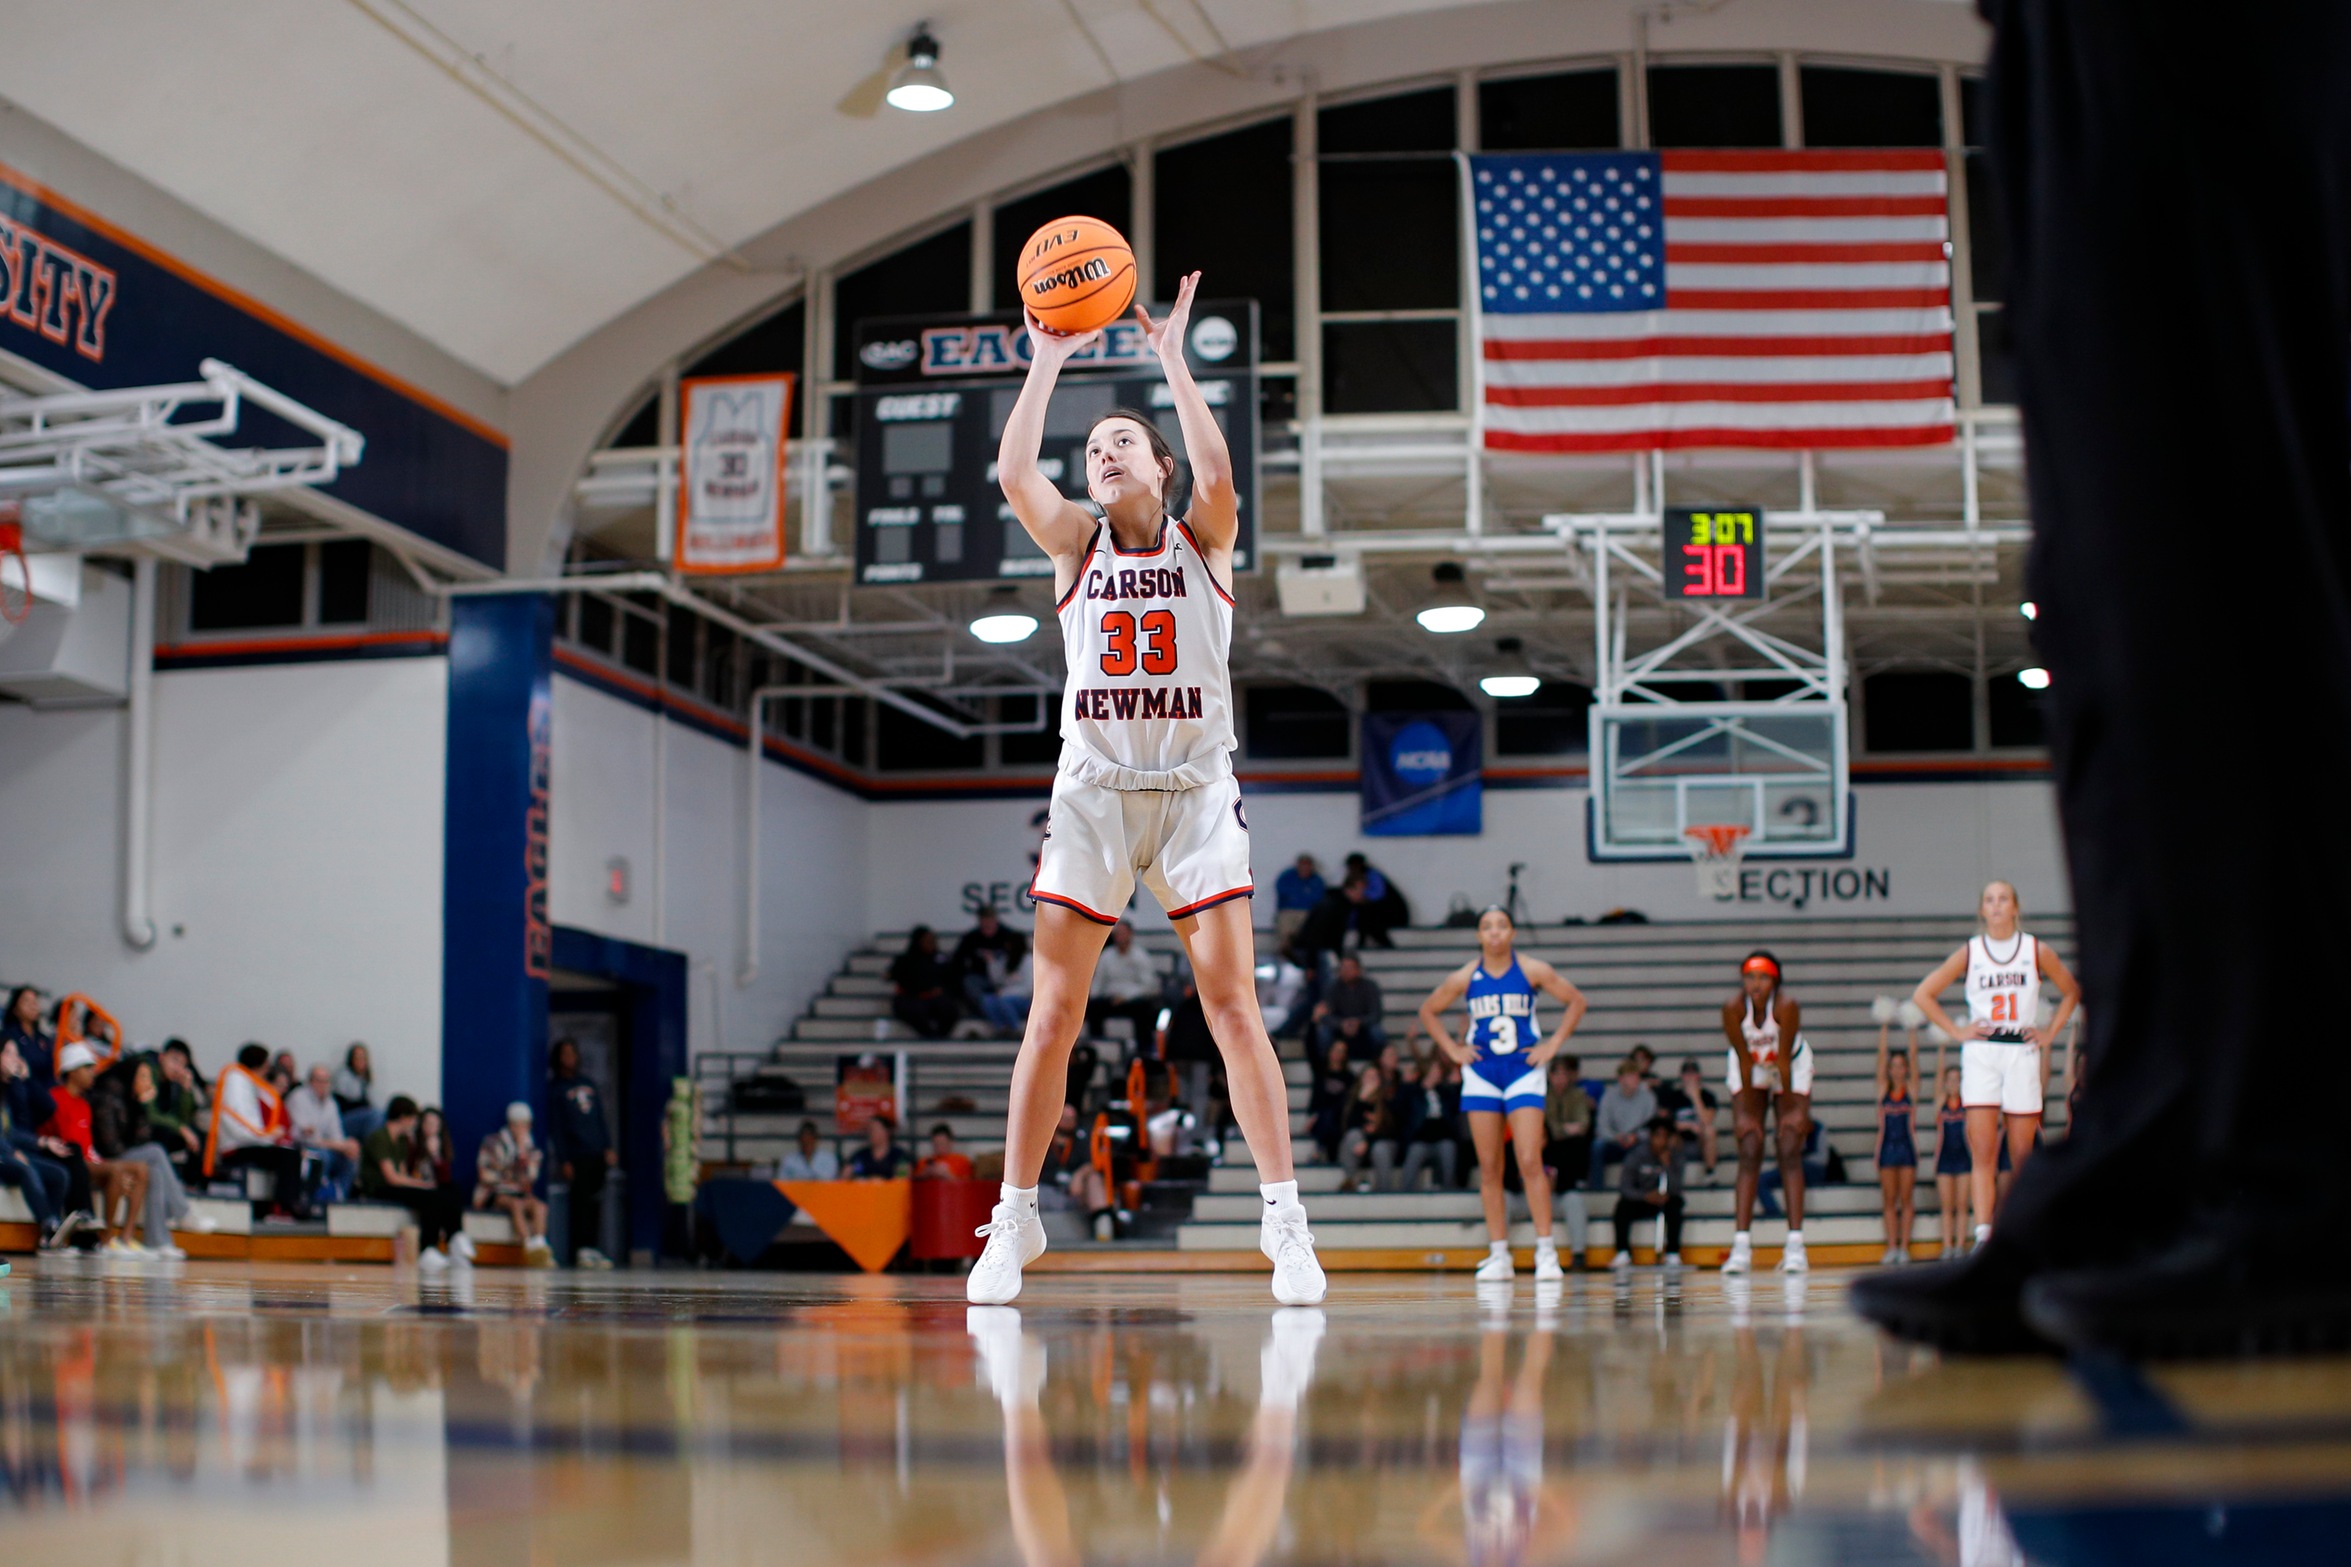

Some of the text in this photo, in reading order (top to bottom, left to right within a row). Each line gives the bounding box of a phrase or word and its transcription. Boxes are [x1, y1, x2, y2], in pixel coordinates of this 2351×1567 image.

[1035, 229, 1079, 257] EVO
[1032, 256, 1111, 295] Wilson
[875, 393, 961, 421] GUEST
[1086, 566, 1188, 601] CARSON
[1682, 544, 1746, 596] 30
[1100, 609, 1178, 677] 33
[1075, 686, 1203, 721] NEWMAN
[1979, 972, 2027, 989] CARSON
[1991, 993, 2018, 1022] 21
[1488, 1014, 1518, 1056] 3
